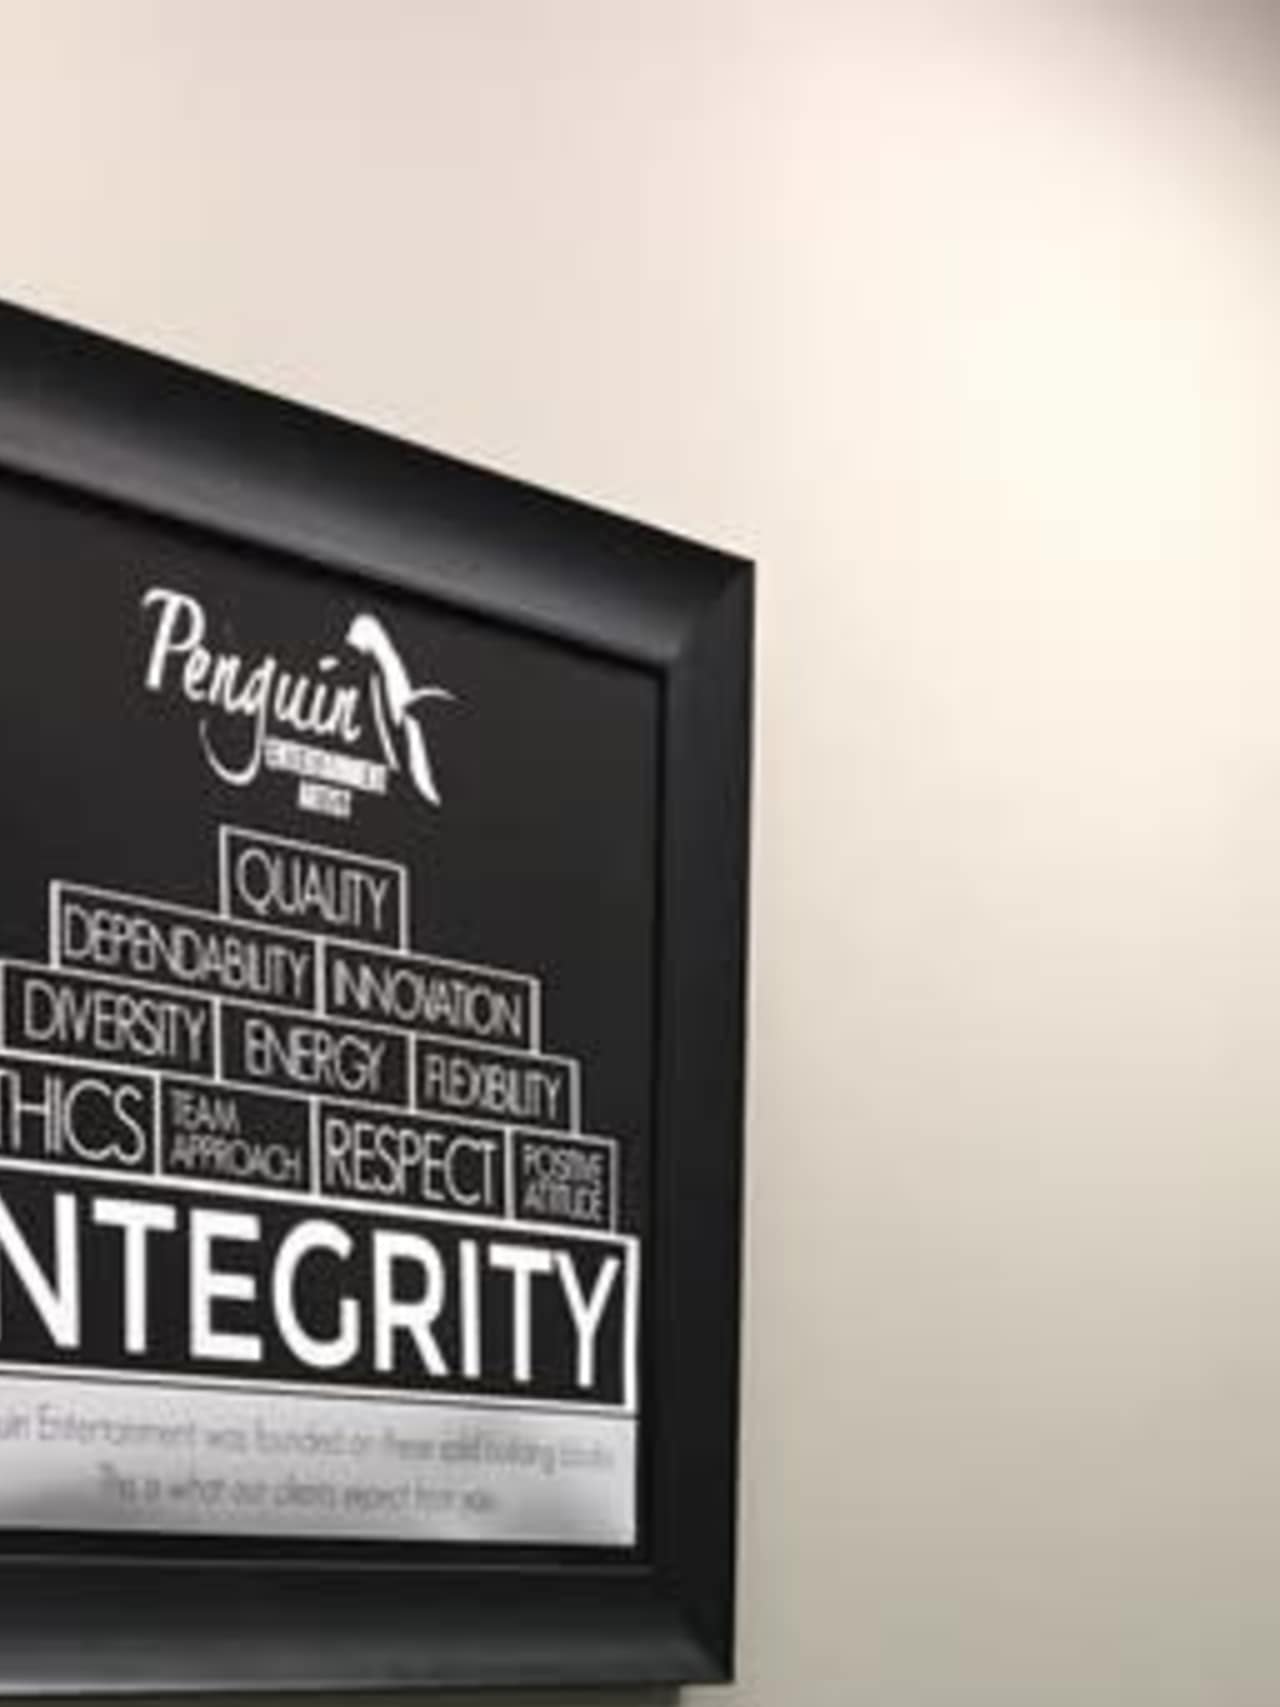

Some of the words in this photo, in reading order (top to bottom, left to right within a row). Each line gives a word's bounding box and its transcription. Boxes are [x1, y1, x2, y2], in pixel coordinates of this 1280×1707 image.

[142, 588, 361, 786] Penguin
[235, 848, 391, 931] QUALITY
[64, 904, 310, 998] DEPENDABILITY
[24, 979, 206, 1061] DIVERSITY
[333, 958, 521, 1038] INNOVATION
[244, 1018, 385, 1093] ENERGY
[174, 1090, 239, 1133] TEAM
[170, 1134, 302, 1183] APPROACH
[324, 1119, 497, 1207] RESPECT
